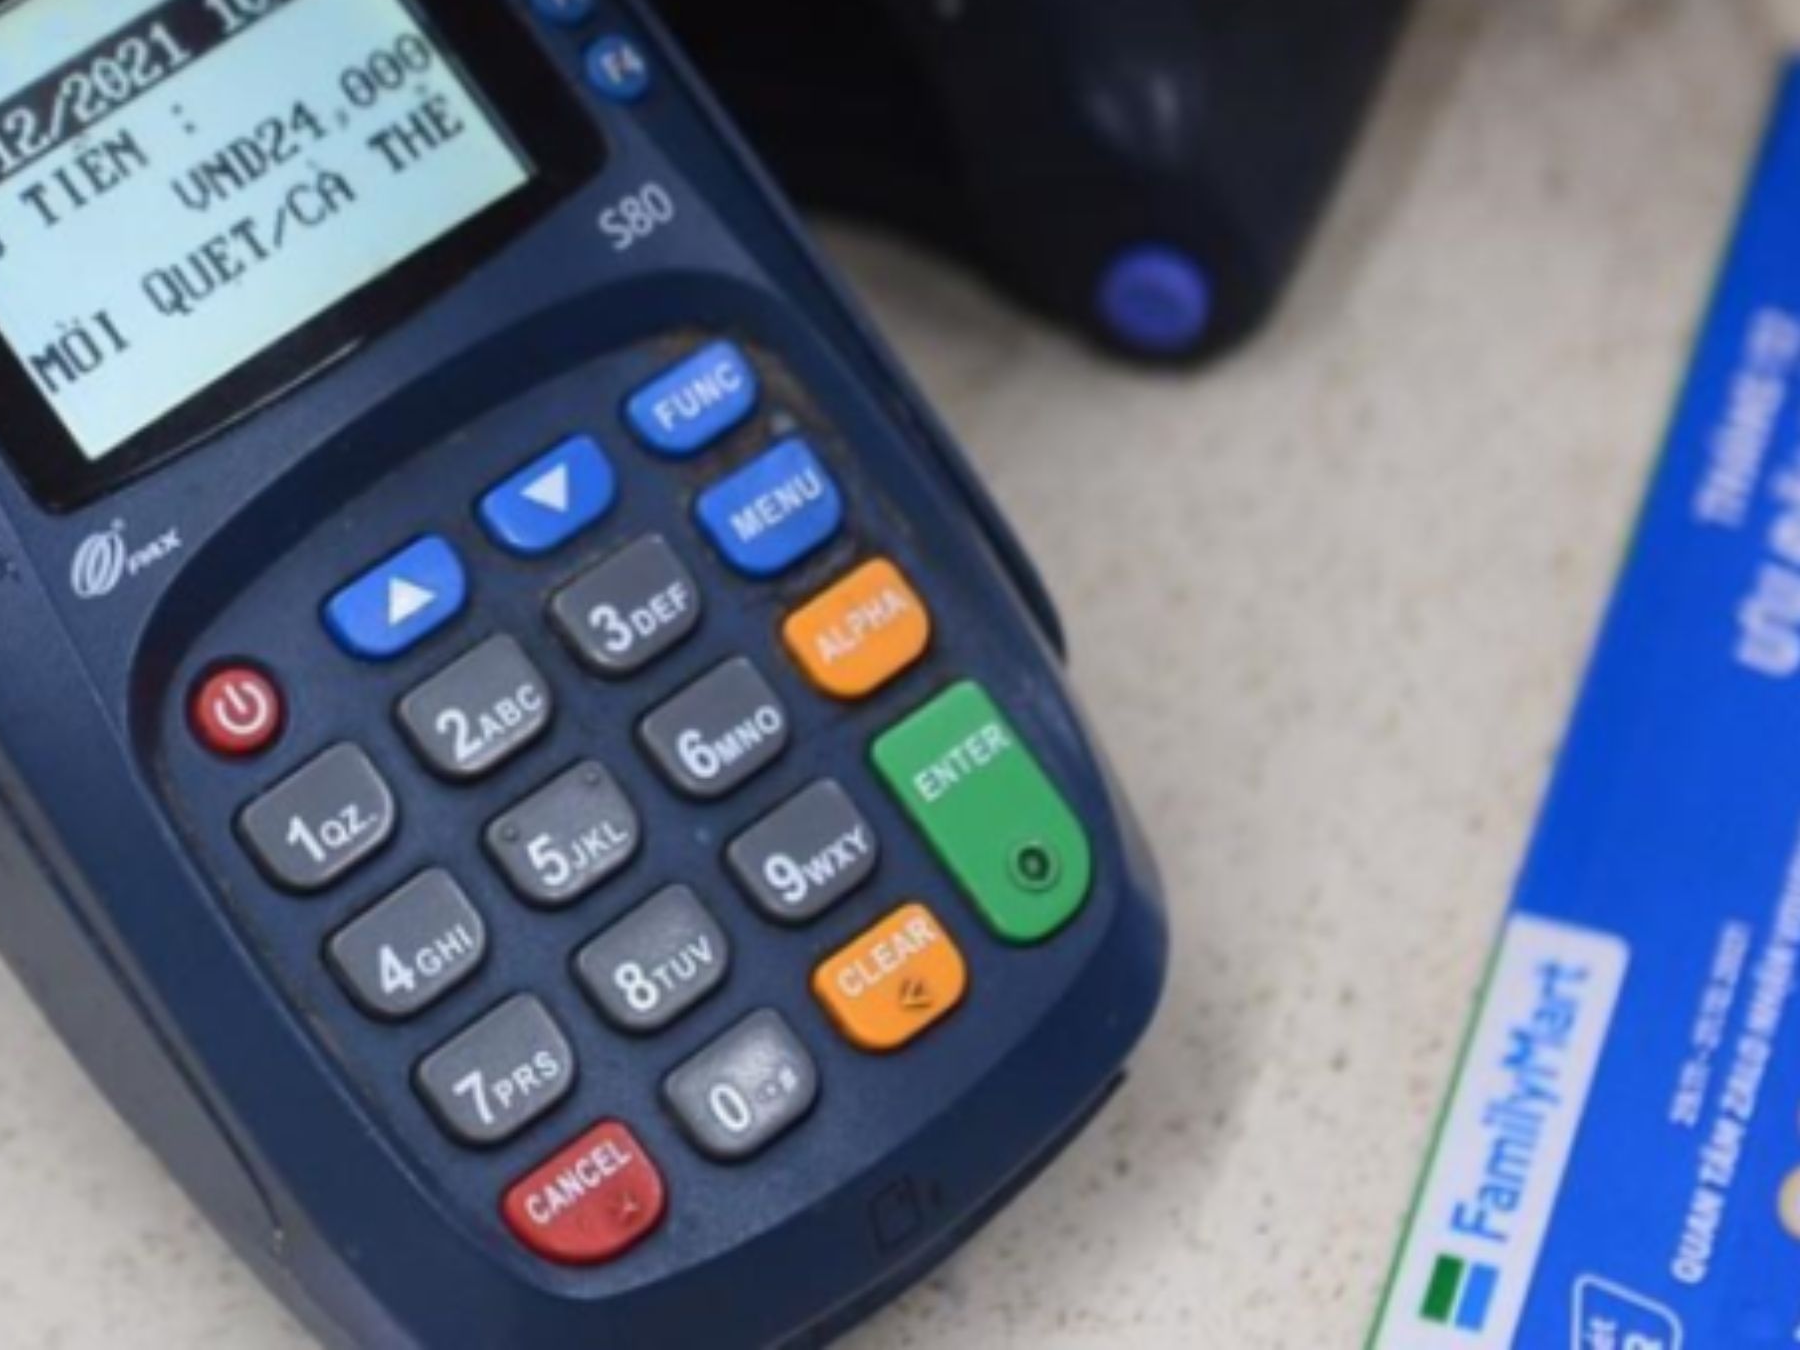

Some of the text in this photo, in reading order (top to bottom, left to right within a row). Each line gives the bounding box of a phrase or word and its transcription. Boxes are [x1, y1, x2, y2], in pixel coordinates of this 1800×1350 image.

[603, 41, 645, 86] F4
[170, 32, 434, 212] VND24,000
[598, 182, 674, 252] S80
[652, 361, 742, 433] FUNC
[729, 466, 824, 544] MENU
[813, 587, 908, 665] ALPHA
[913, 721, 1013, 804] ENTER
[835, 913, 940, 999] CLEAR
[1449, 957, 1591, 1244] FamilyMart
[523, 1138, 634, 1225] CANCEL
